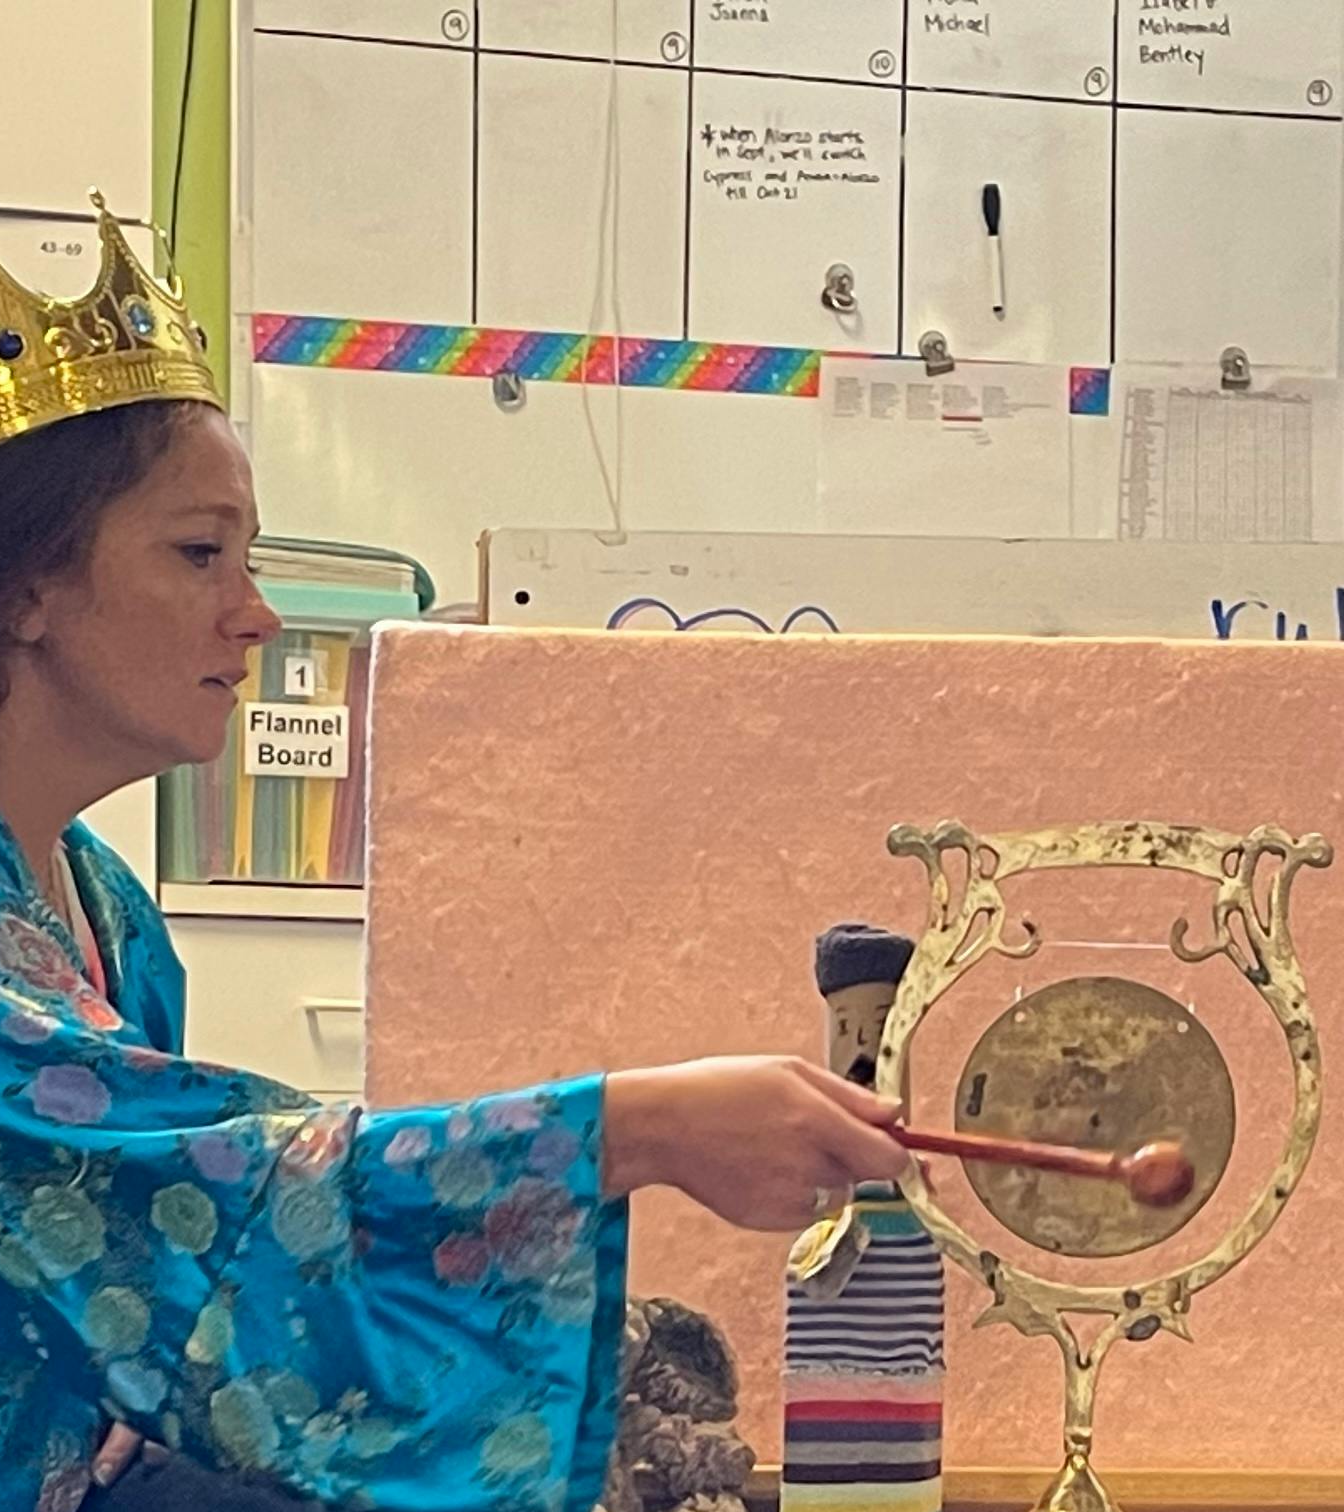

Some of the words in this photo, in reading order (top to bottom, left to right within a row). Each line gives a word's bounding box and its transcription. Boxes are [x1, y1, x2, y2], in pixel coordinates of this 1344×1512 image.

[923, 12, 990, 37] Michael
[1138, 44, 1206, 76] Bentley
[39, 240, 83, 257] 43-69
[294, 665, 306, 688] 1
[249, 710, 343, 737] Flannel
[257, 743, 333, 768] Board
